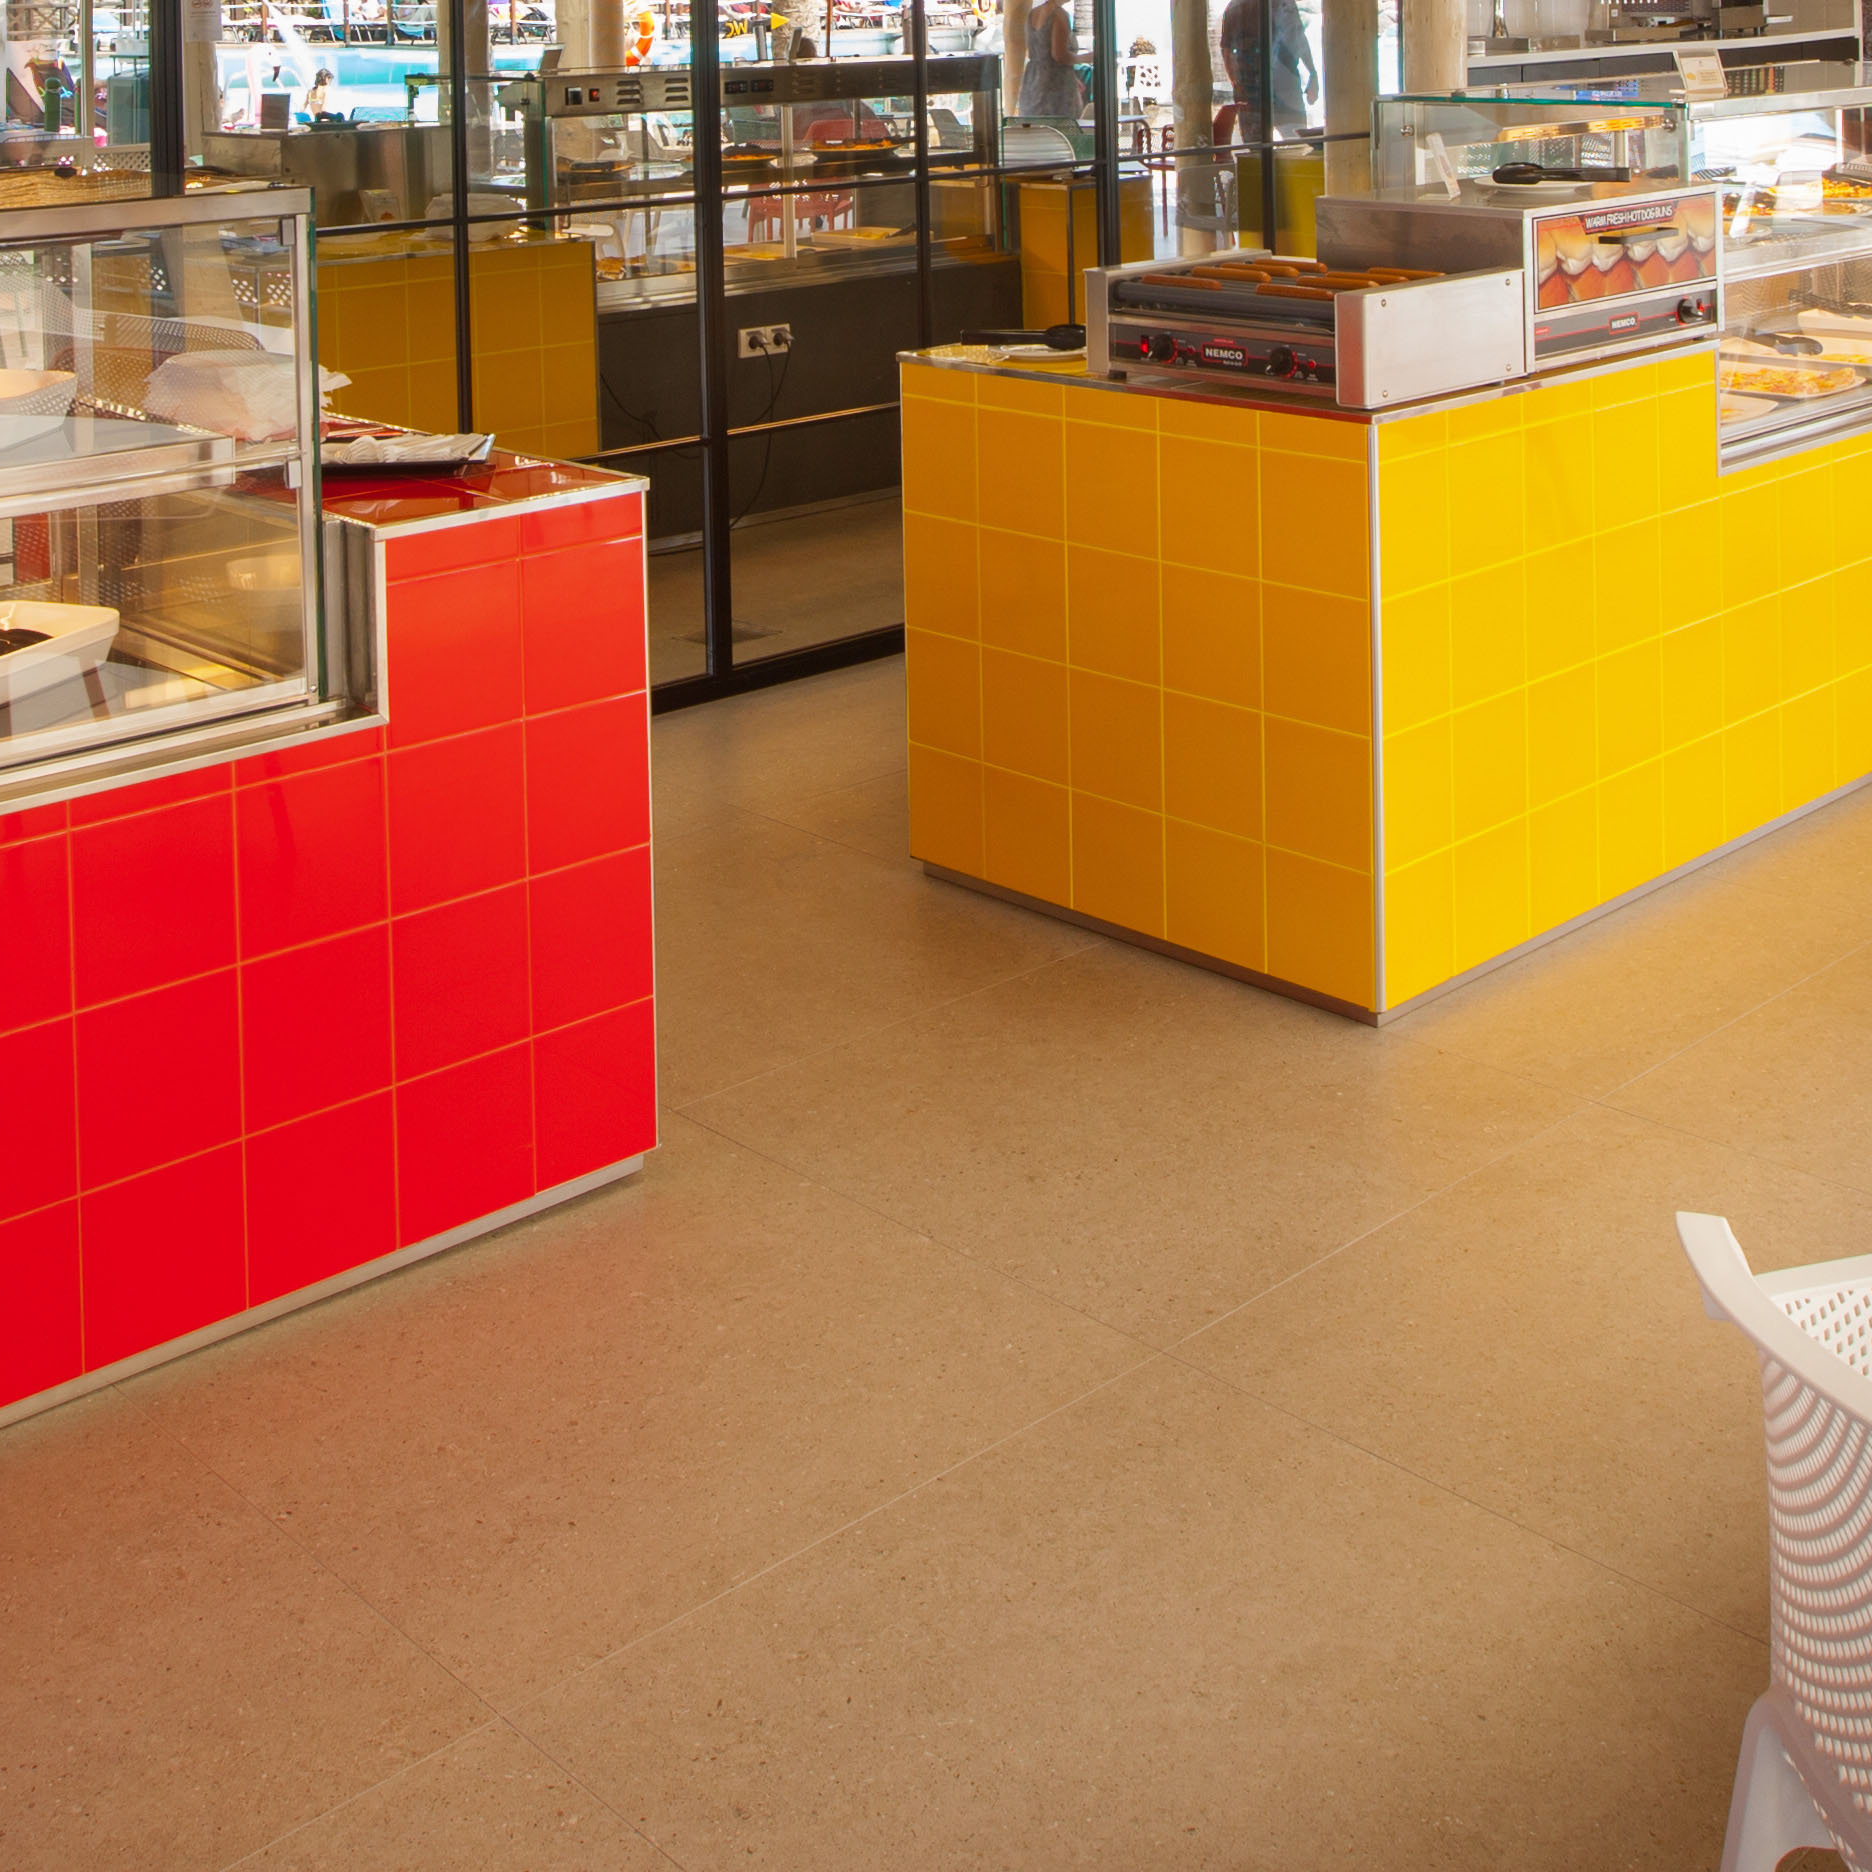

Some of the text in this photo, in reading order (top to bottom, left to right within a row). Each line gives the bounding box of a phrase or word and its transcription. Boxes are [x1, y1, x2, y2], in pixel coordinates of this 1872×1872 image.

[1585, 215, 1606, 229] WARM
[1607, 211, 1626, 225] FRESH
[1627, 210, 1640, 222] HOT
[1611, 317, 1636, 329] NEMCO
[1205, 347, 1243, 360] NEMCO
